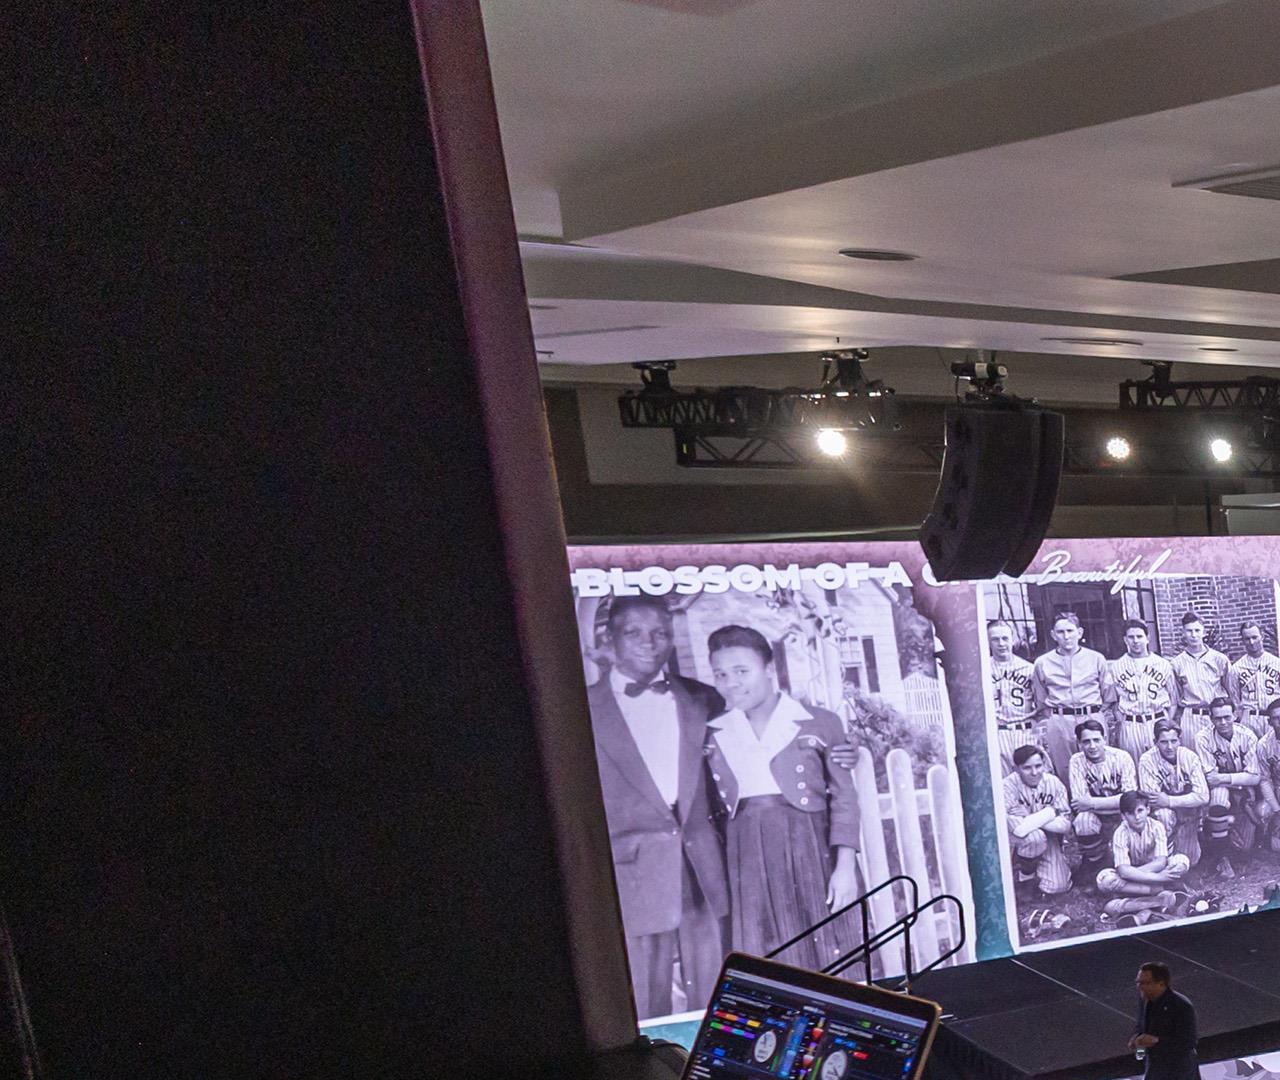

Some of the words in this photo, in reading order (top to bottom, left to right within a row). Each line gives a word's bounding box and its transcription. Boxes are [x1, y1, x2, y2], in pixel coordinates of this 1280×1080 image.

[575, 563, 800, 598] BLOSSOM
[814, 561, 870, 591] OF
[881, 561, 914, 588] A
[1036, 549, 1173, 596] Beautiful
